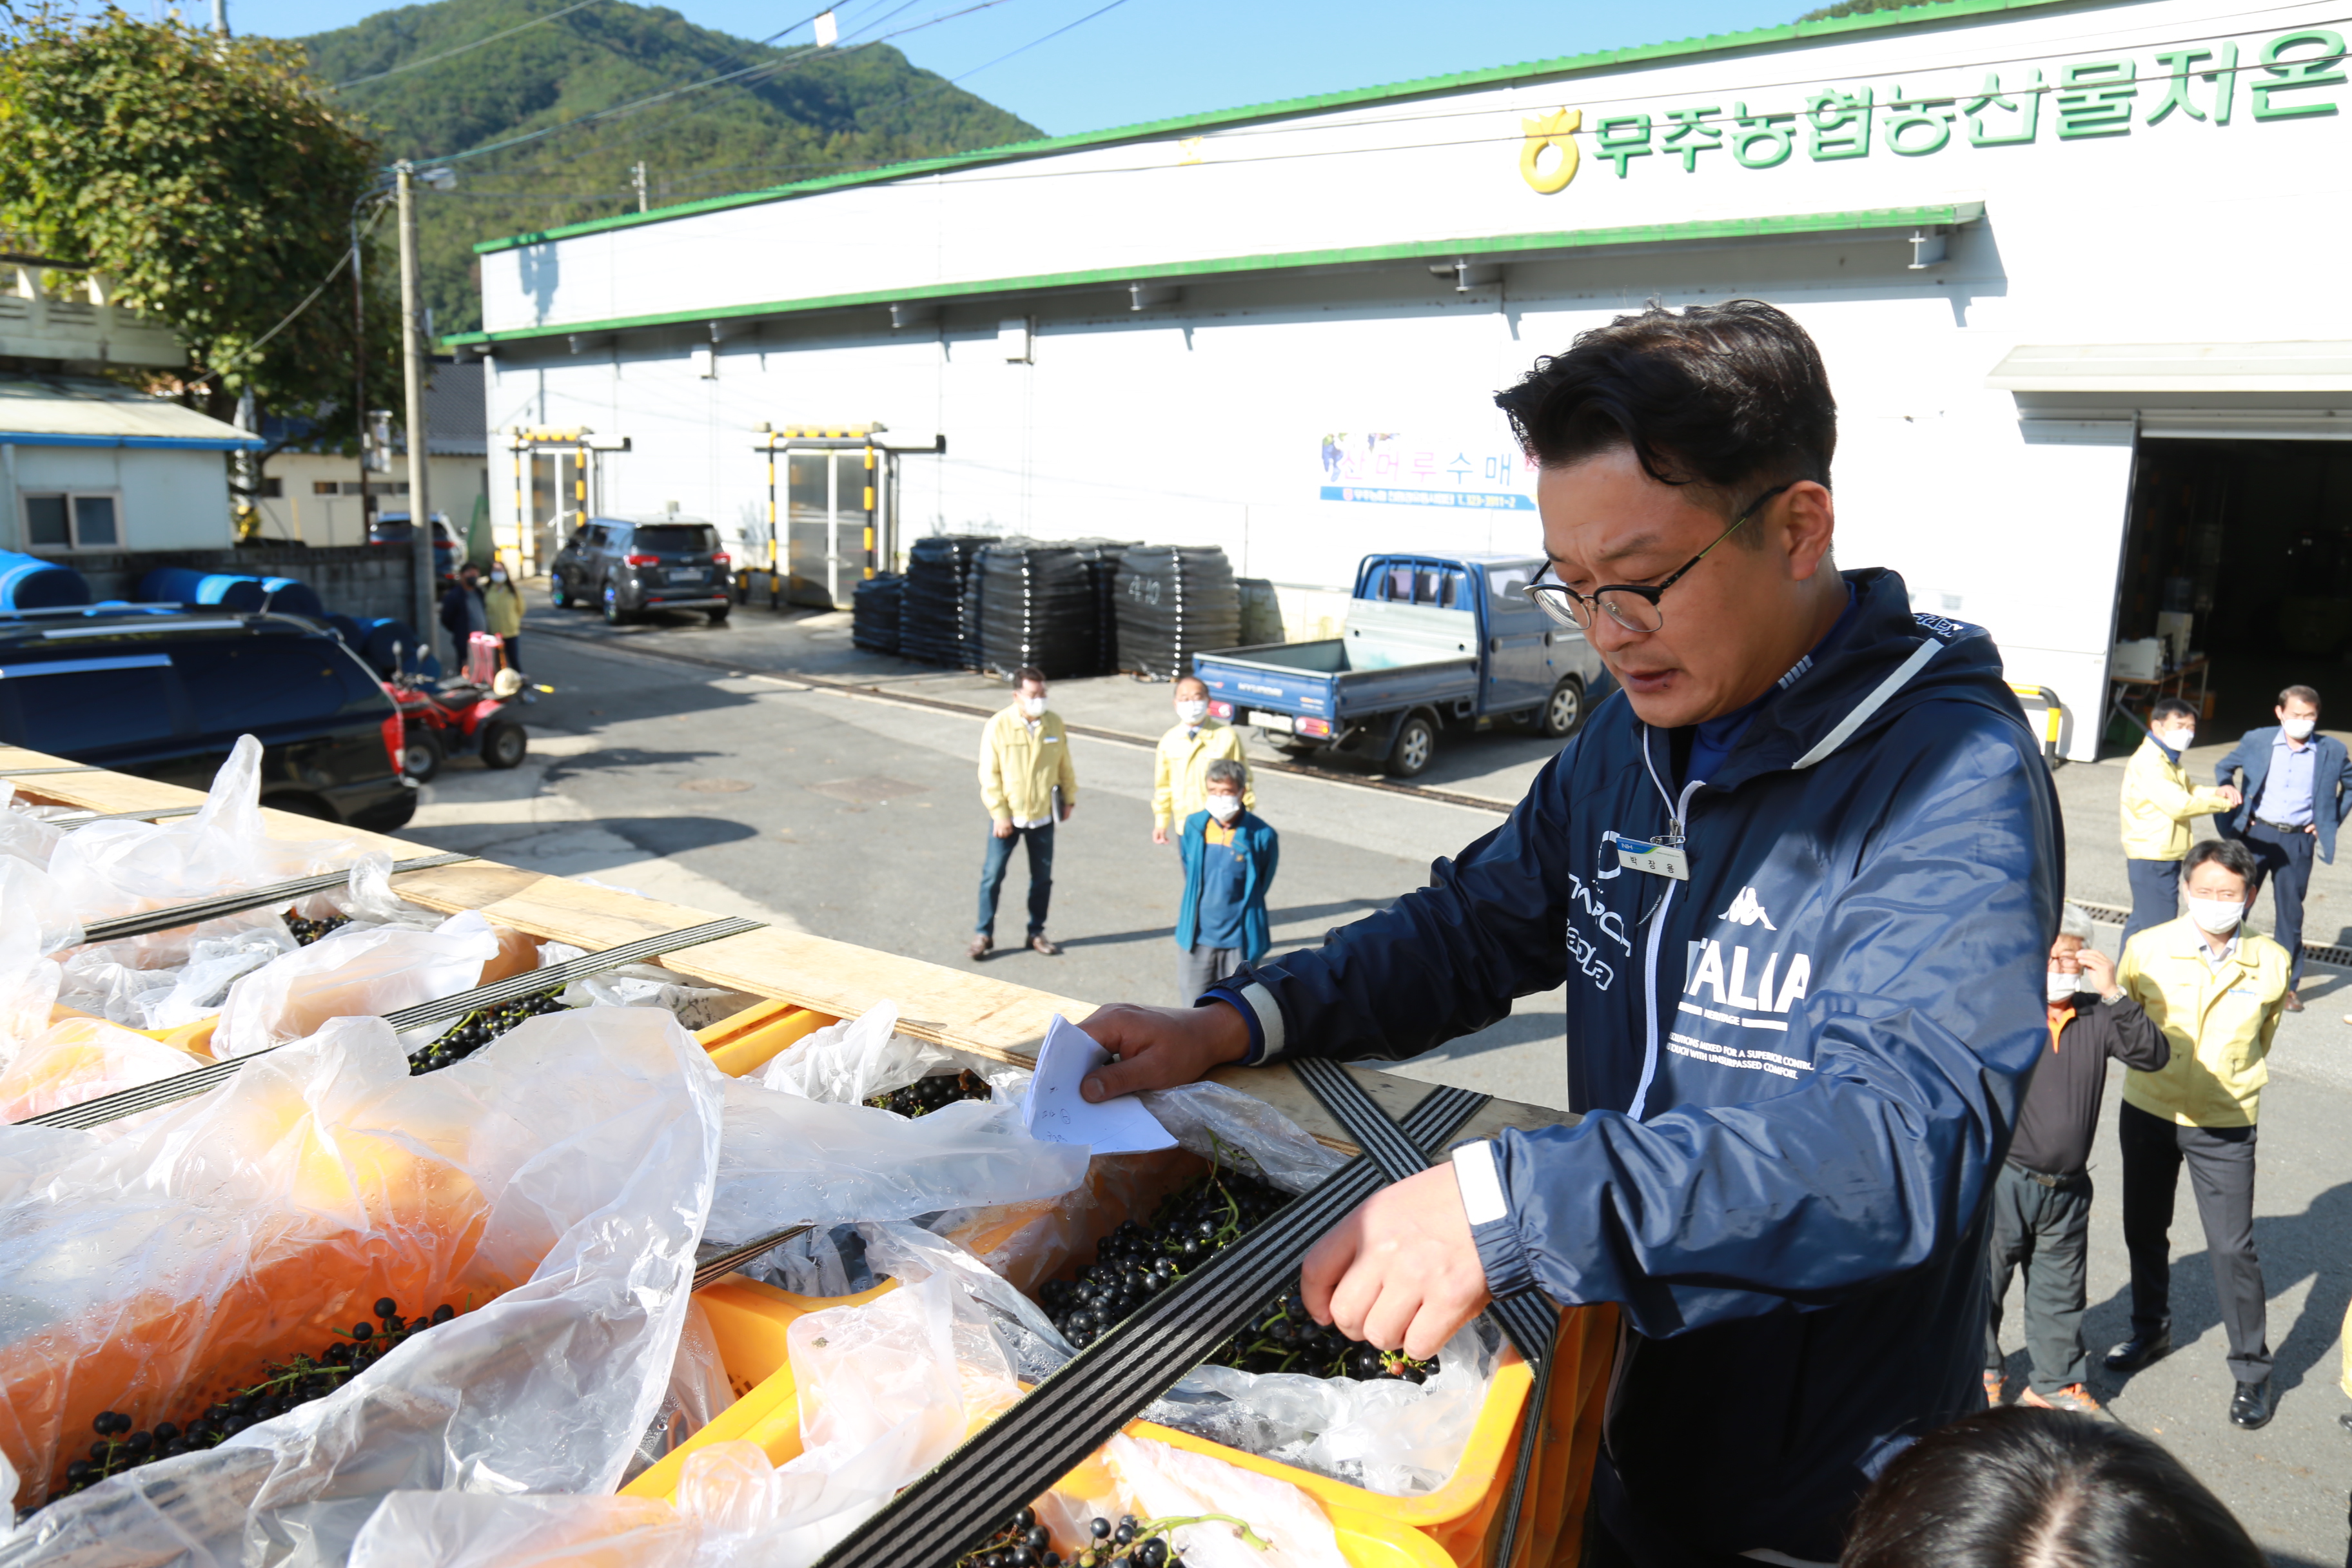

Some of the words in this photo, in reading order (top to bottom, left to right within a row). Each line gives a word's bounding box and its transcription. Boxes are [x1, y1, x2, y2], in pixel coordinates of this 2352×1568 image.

[1593, 28, 2347, 179] 무주농협농산물저온
[1683, 937, 1811, 1013] TALIA
[1704, 1009, 1740, 1025] HERITAGE
[1670, 1043, 1689, 1057] TOUCH
[1690, 1049, 1708, 1061] WITH
[1709, 1054, 1763, 1070] UNSURPASSED
[1763, 1063, 1798, 1080] COMFORT.
[1699, 1041, 1723, 1053] MIXED
[1723, 1046, 1738, 1057] FOR
[1738, 1049, 1746, 1058] A
[1747, 1050, 1783, 1064] SUPERIOR
